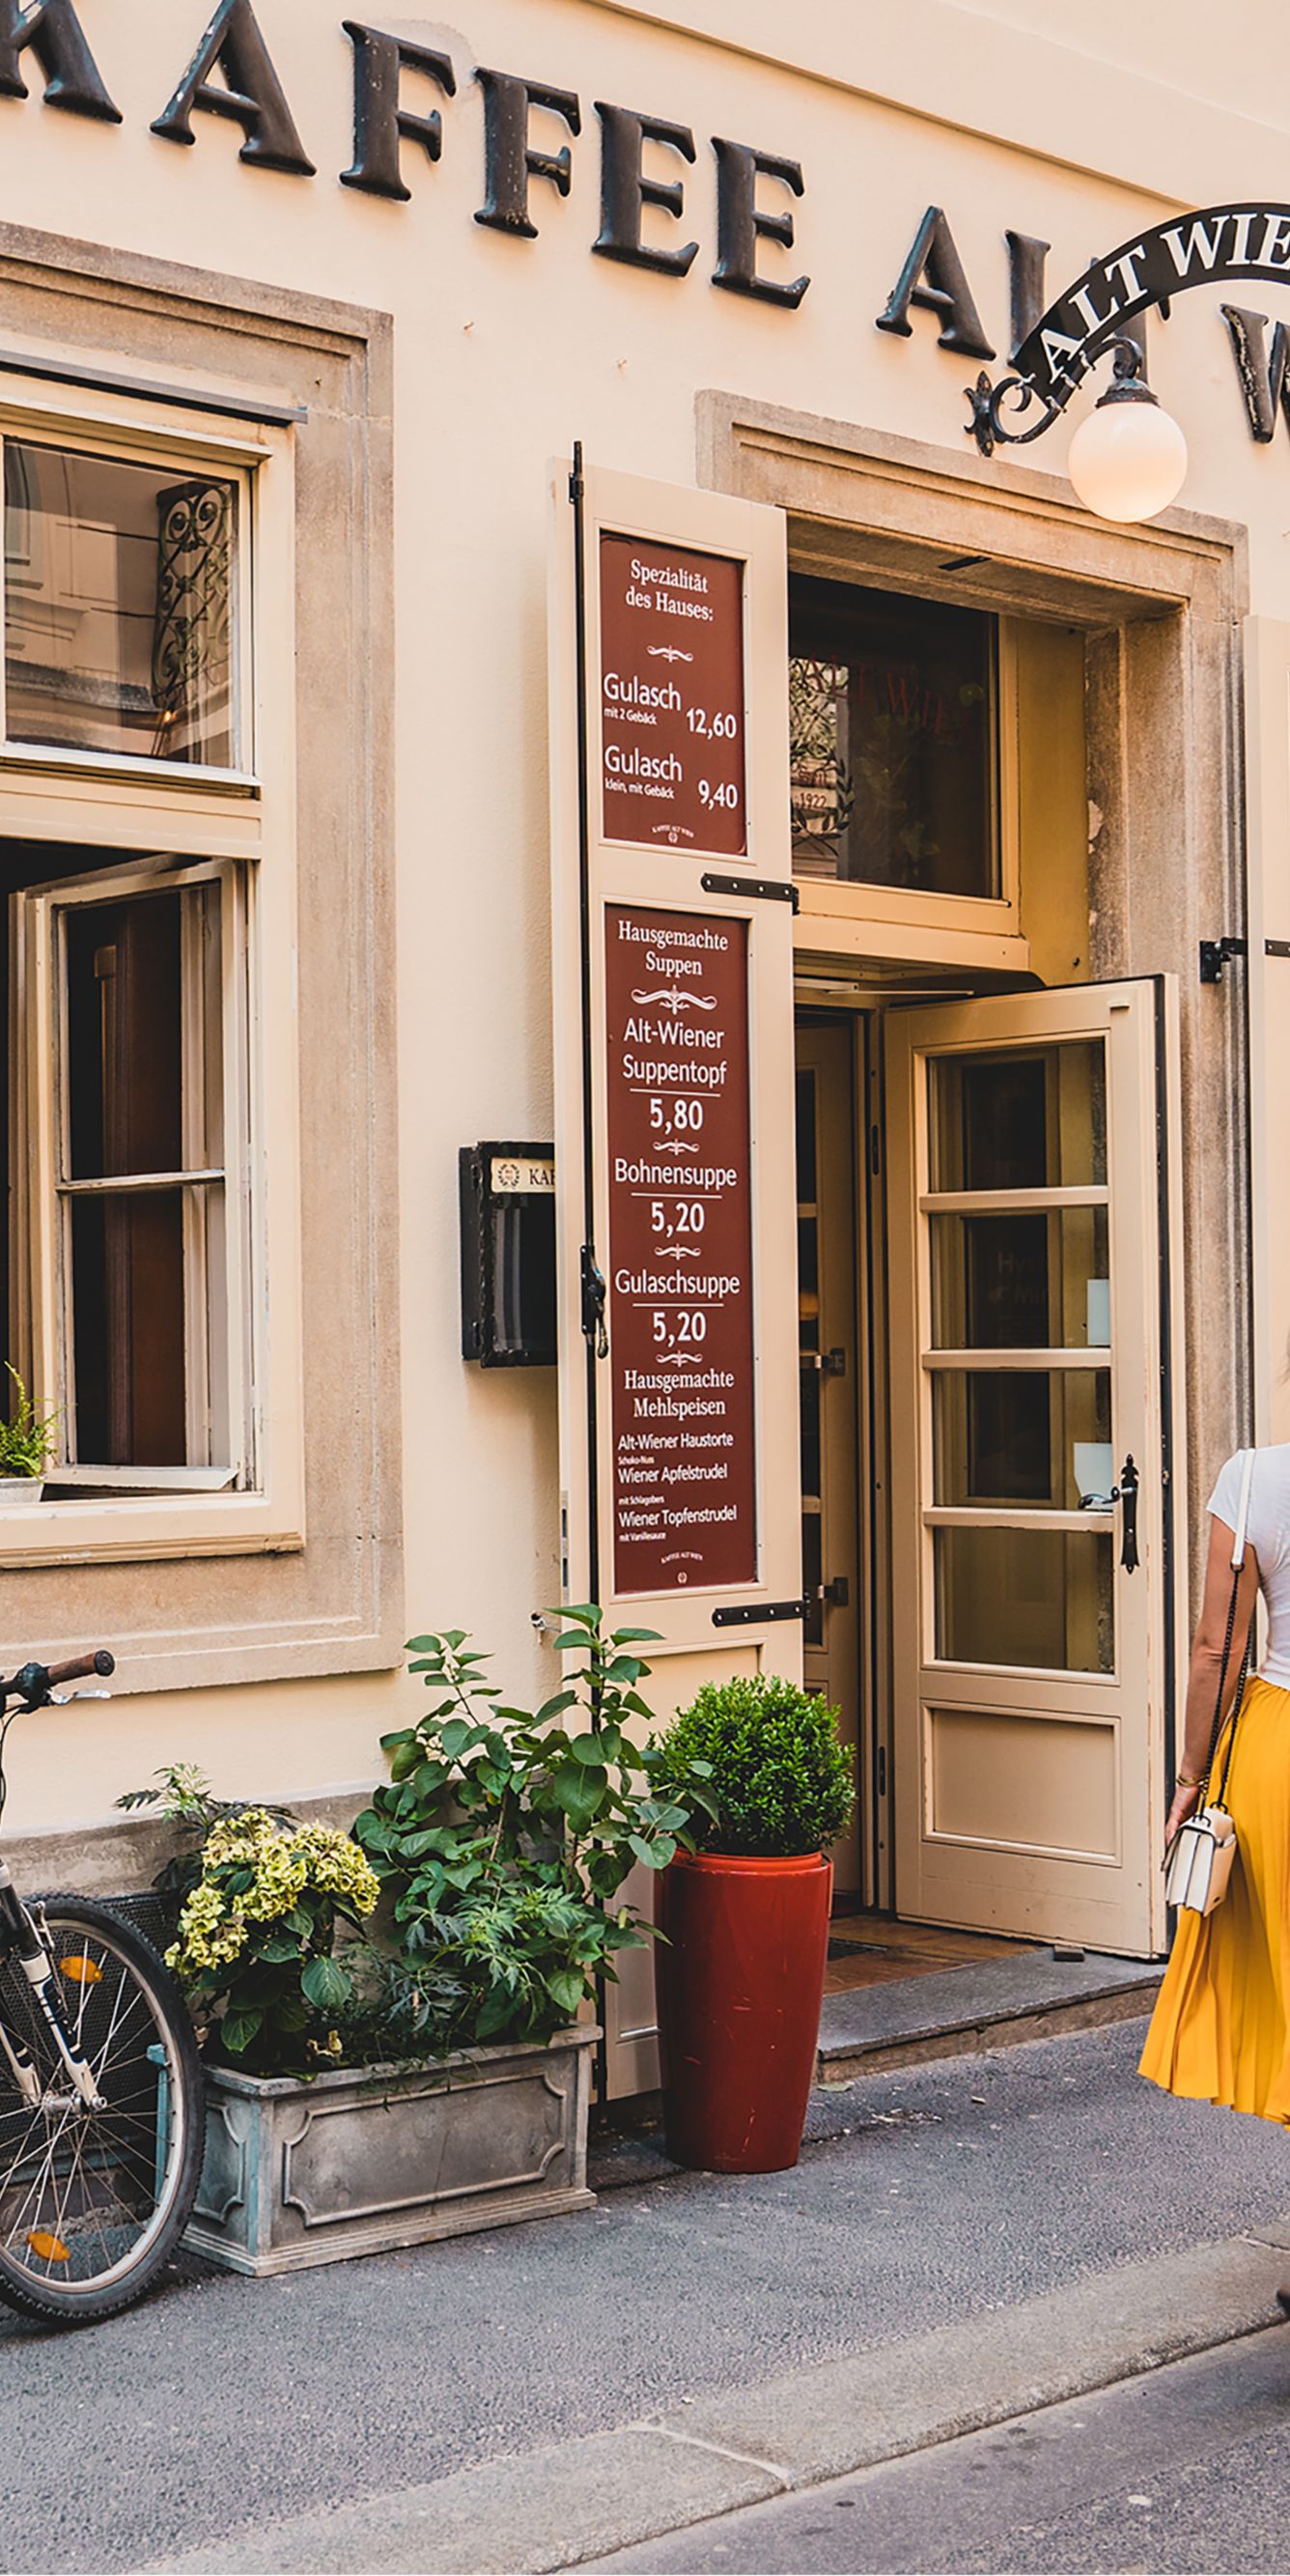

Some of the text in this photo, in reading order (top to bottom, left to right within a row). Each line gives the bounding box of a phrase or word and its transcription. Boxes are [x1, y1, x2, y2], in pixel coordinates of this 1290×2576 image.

[875, 205, 1171, 398] AL
[1039, 243, 1148, 383] ALT
[631, 558, 709, 594] Spezialität
[625, 585, 714, 622] des Hauses:
[603, 672, 737, 740] Gulasch 12,60
[603, 707, 618, 719] mit
[619, 707, 626, 721] 2
[604, 745, 739, 810] Gulasch 9,40
[629, 782, 643, 795] mit
[800, 792, 827, 809] 1922
[618, 920, 729, 951] Hausgemachte
[645, 950, 703, 978] Suppen
[623, 1017, 725, 1049] Alt-Wiener
[622, 1053, 728, 1089] Suppentopf
[650, 1097, 703, 1135] 5,80
[614, 1157, 738, 1191] Bohnensuppe
[651, 1202, 705, 1238] 5,20
[615, 1268, 741, 1299] Gulaschsuppe
[653, 1311, 707, 1347] 5,20
[624, 1368, 735, 1394] Hausgemachte
[633, 1397, 726, 1421] Mehlspeisen
[617, 1432, 734, 1451] Alt-Wiener Haustorte
[618, 1463, 728, 1486] Wiener Apfelstrudel
[618, 1505, 738, 1528] Wiener Topfenstrudel
